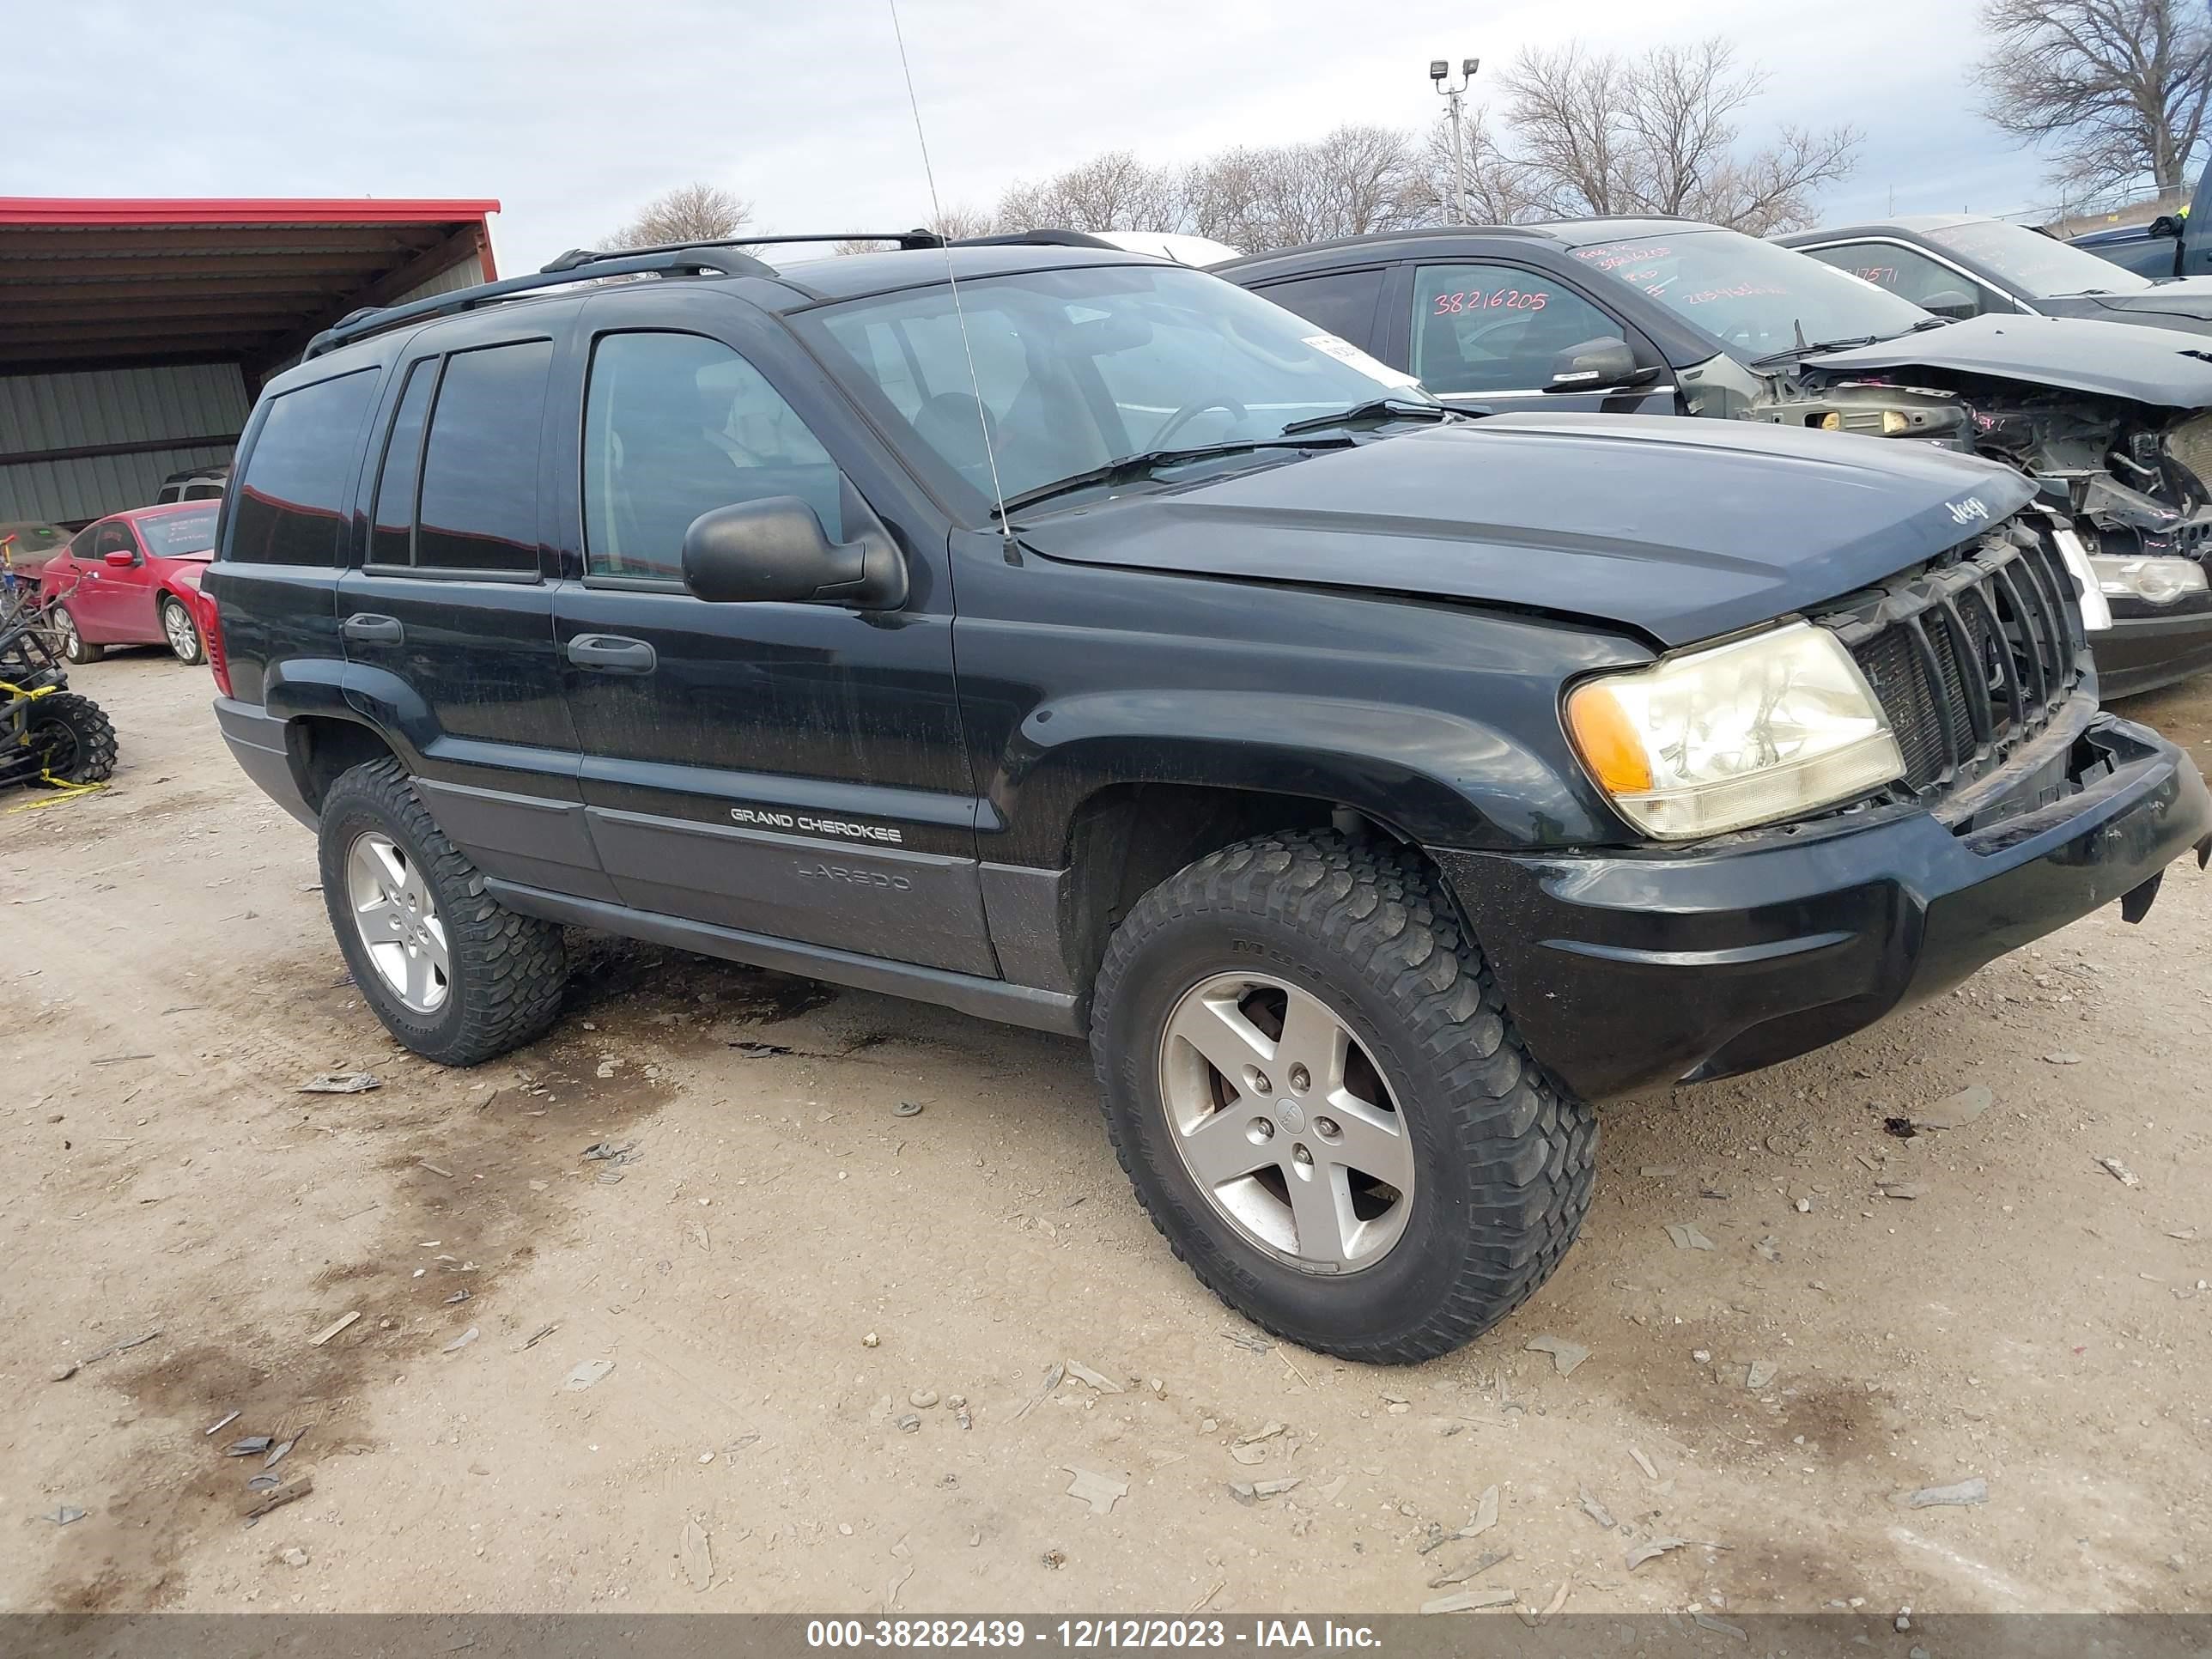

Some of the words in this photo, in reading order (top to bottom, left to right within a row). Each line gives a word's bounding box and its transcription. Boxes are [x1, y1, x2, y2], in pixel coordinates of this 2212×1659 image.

[1433, 288, 1550, 315] 38216205
[1944, 496, 1990, 526] Jeep
[730, 808, 793, 828] GRAND
[797, 817, 902, 843] CHEROKEE
[797, 863, 915, 893] LAREDO
